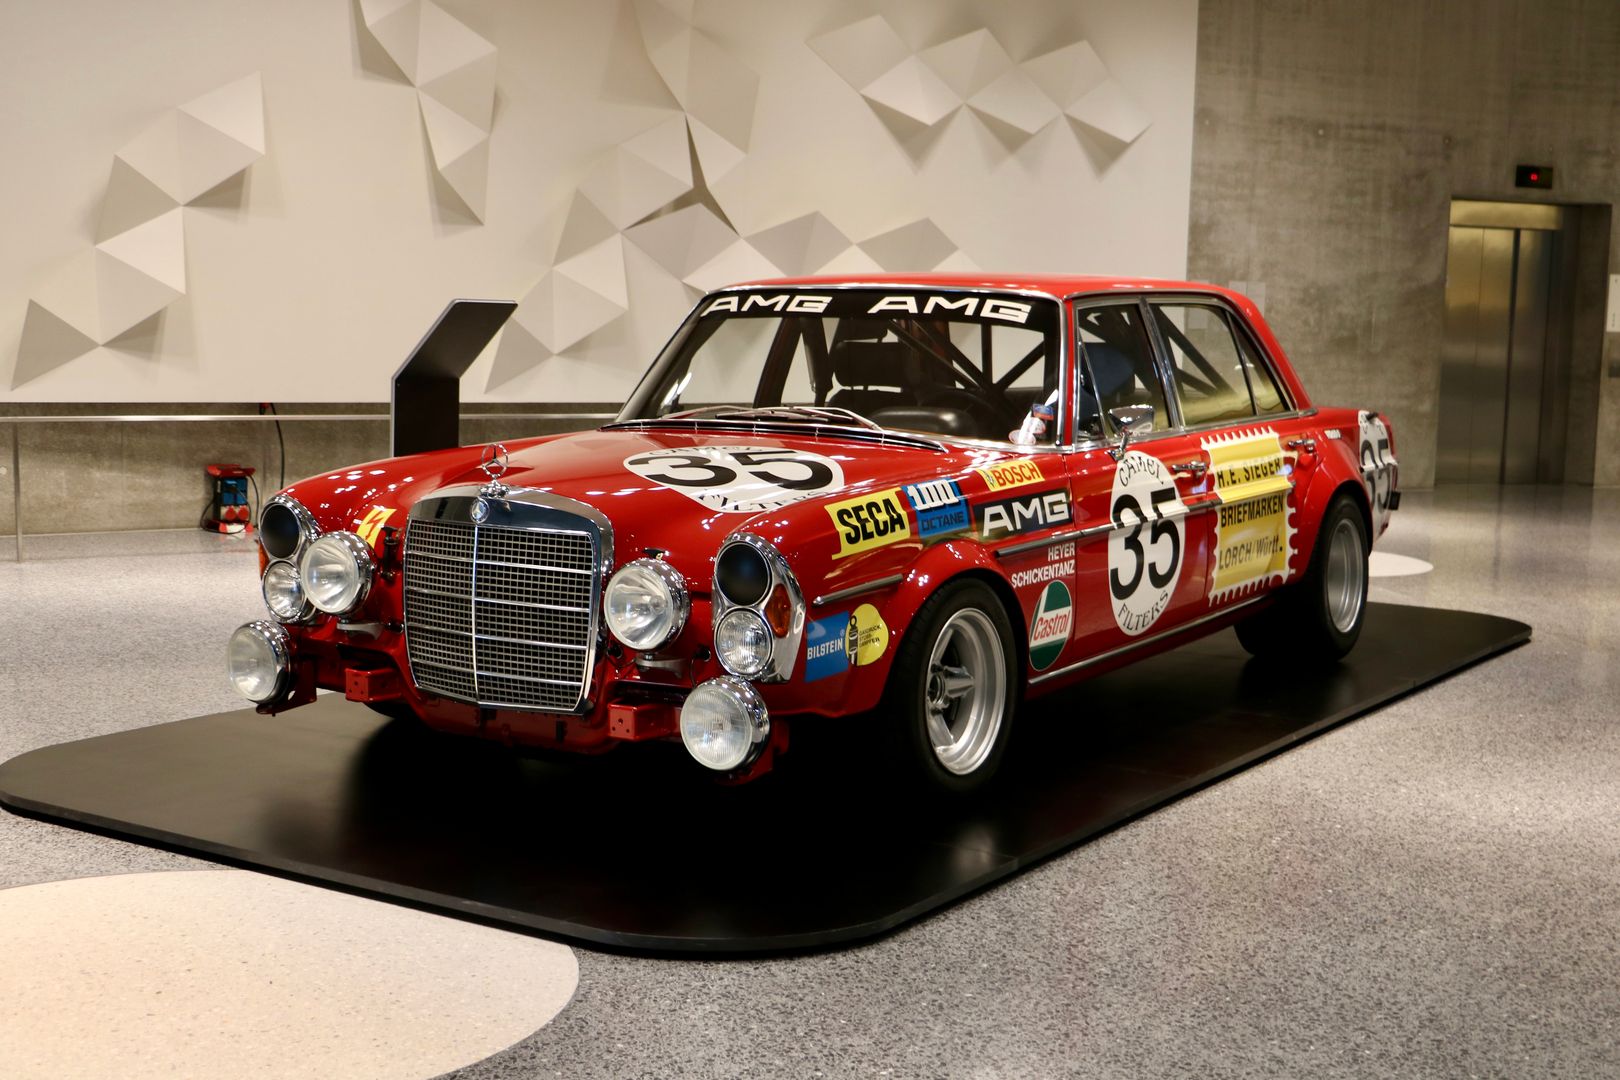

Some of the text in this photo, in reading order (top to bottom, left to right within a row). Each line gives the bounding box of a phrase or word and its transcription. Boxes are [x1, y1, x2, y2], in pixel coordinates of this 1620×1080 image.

[700, 294, 1033, 324] AMG AMG
[628, 450, 833, 491] 35
[991, 462, 1040, 487] BOSCH
[1118, 455, 1165, 488] CAMEL
[1243, 457, 1282, 482] SIEGER
[1361, 439, 1391, 514] 35
[906, 479, 960, 511] 100
[1220, 493, 1285, 528] BRIEFMARKEN
[836, 498, 906, 545] SECA
[921, 511, 965, 532] OCTANE
[982, 491, 1070, 537] AMG
[1047, 542, 1076, 562] HEYER
[1109, 486, 1181, 601] 35
[1011, 559, 1076, 589] SCHICKENTANZ
[1033, 612, 1071, 641] Castrol
[1117, 589, 1169, 632] FILTERS
[807, 637, 843, 661] BILSTEIN
